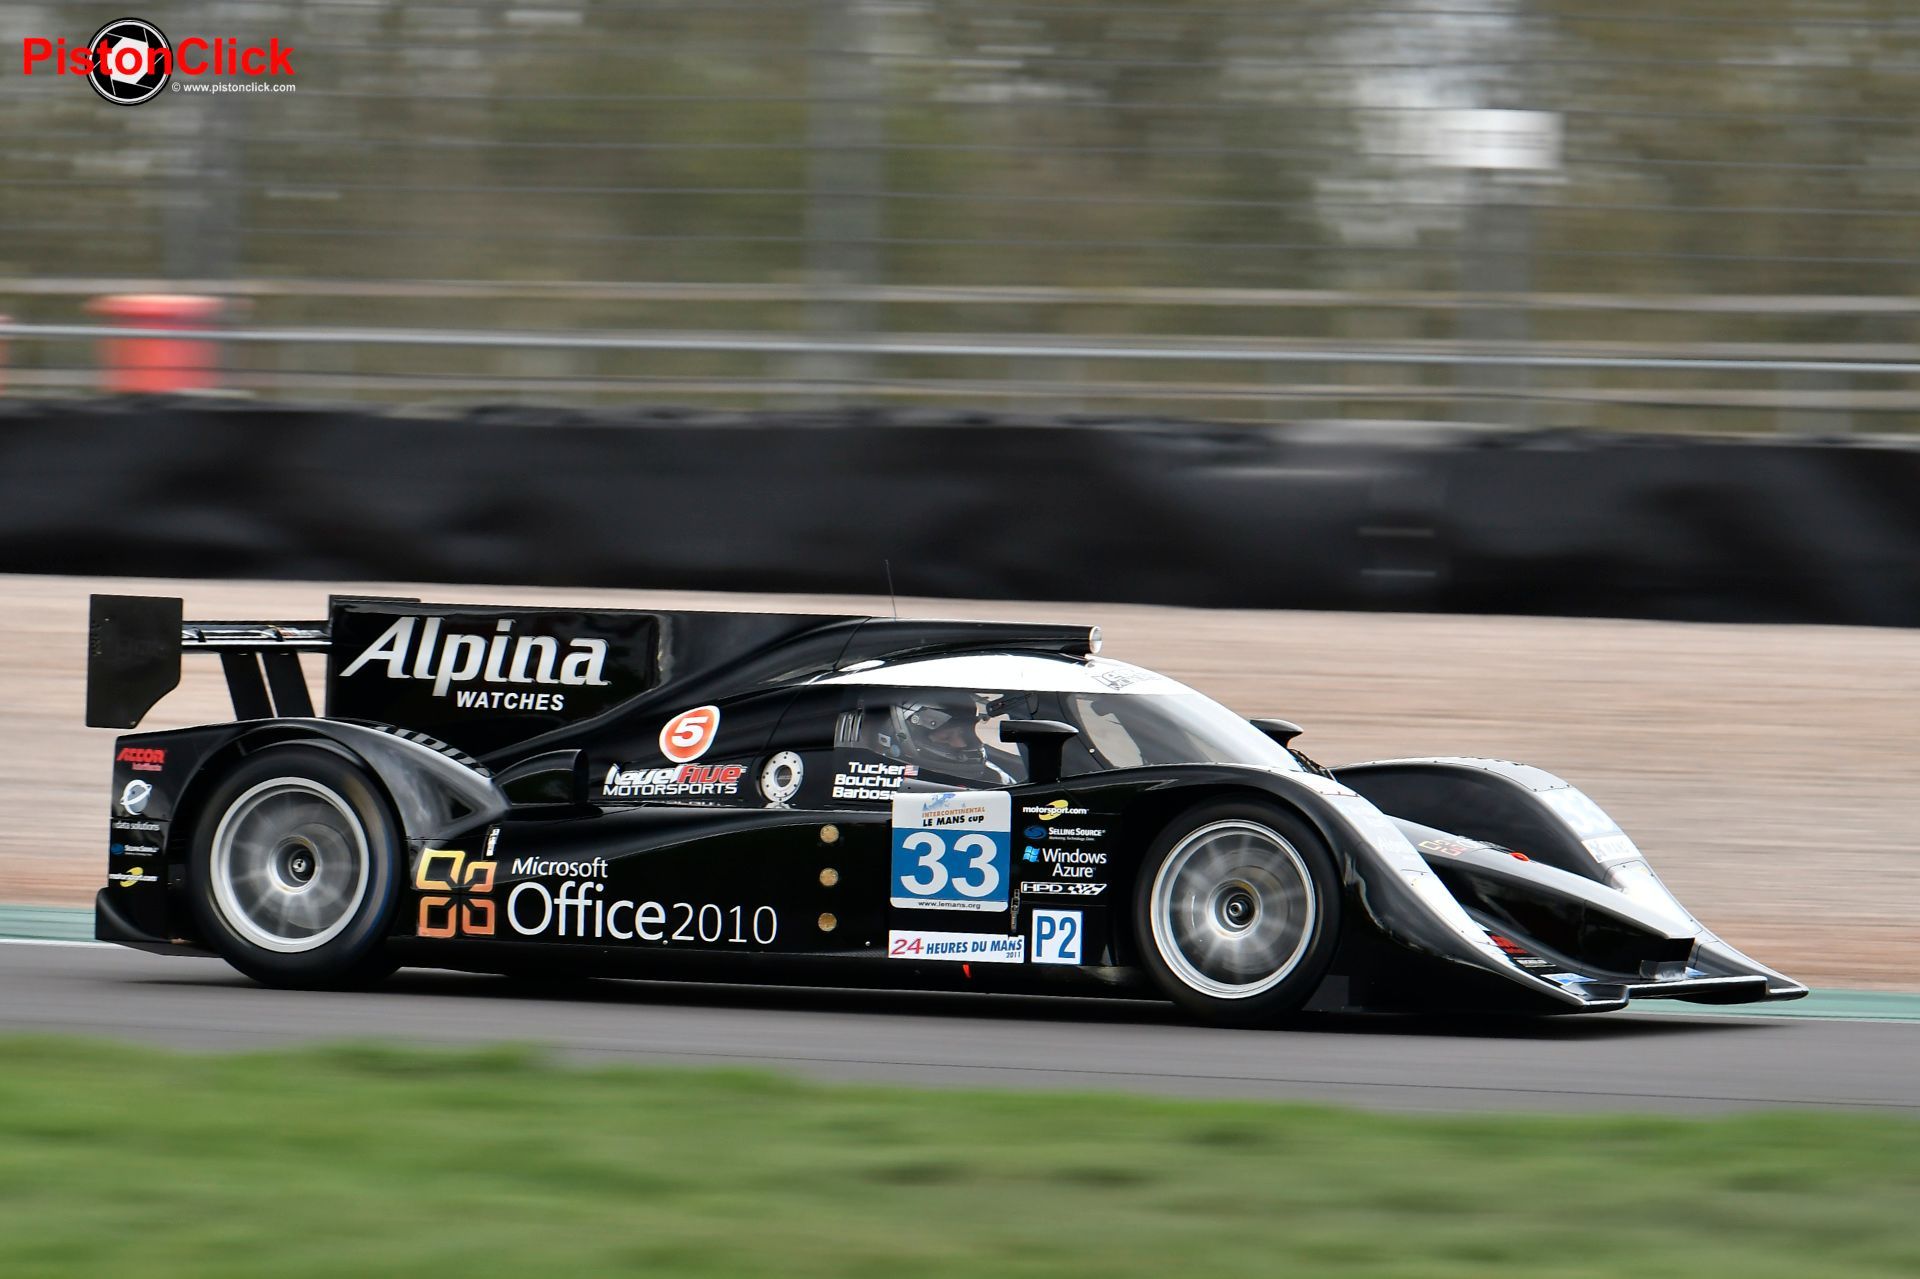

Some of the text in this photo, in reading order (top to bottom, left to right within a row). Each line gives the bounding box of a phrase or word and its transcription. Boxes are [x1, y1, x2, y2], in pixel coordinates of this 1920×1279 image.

[339, 616, 612, 697] Alpina
[456, 691, 565, 711] WATCHES
[671, 716, 709, 747] 5
[848, 762, 905, 775] Tucker
[834, 774, 903, 787] Bouchut
[602, 783, 738, 796] MOTORSPORTS
[922, 806, 986, 818] INTERCONTINENTAL
[1022, 805, 1087, 816] motorsport.com
[923, 815, 984, 827] LE MANS cup
[1042, 848, 1107, 864] Windows
[511, 857, 608, 878] Microsoft
[900, 831, 1000, 897] 33
[1052, 863, 1093, 878] Azure
[1023, 883, 1063, 892] HPD
[507, 880, 778, 945] Office 2010
[918, 901, 981, 909] www.lemans.org
[1035, 915, 1077, 959] P2
[891, 937, 1023, 955] 24 HEURES DU MANS
[1006, 951, 1021, 959] 2011
